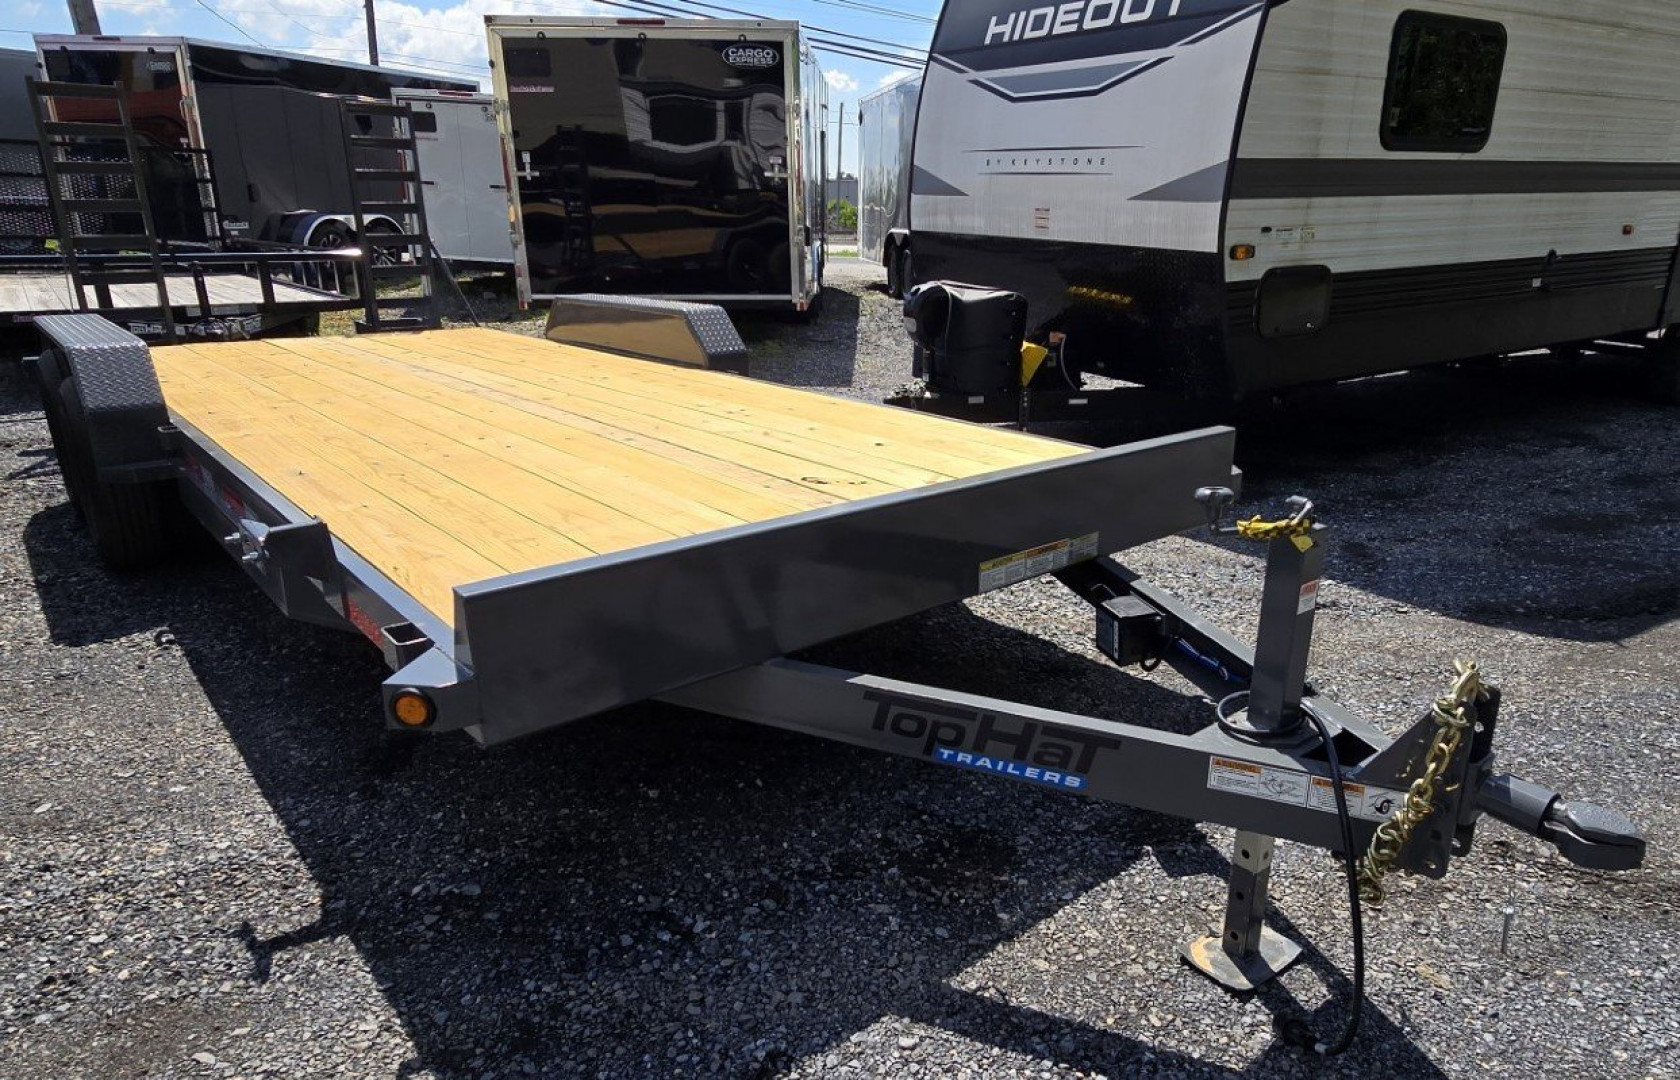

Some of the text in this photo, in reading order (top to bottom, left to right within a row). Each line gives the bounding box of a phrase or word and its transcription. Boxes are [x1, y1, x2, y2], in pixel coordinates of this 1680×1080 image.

[728, 48, 773, 58] CARGO
[728, 57, 773, 65] EXPRESS
[1011, 157, 1106, 166] KEYSTONE
[939, 748, 1082, 788] TRAILERS
